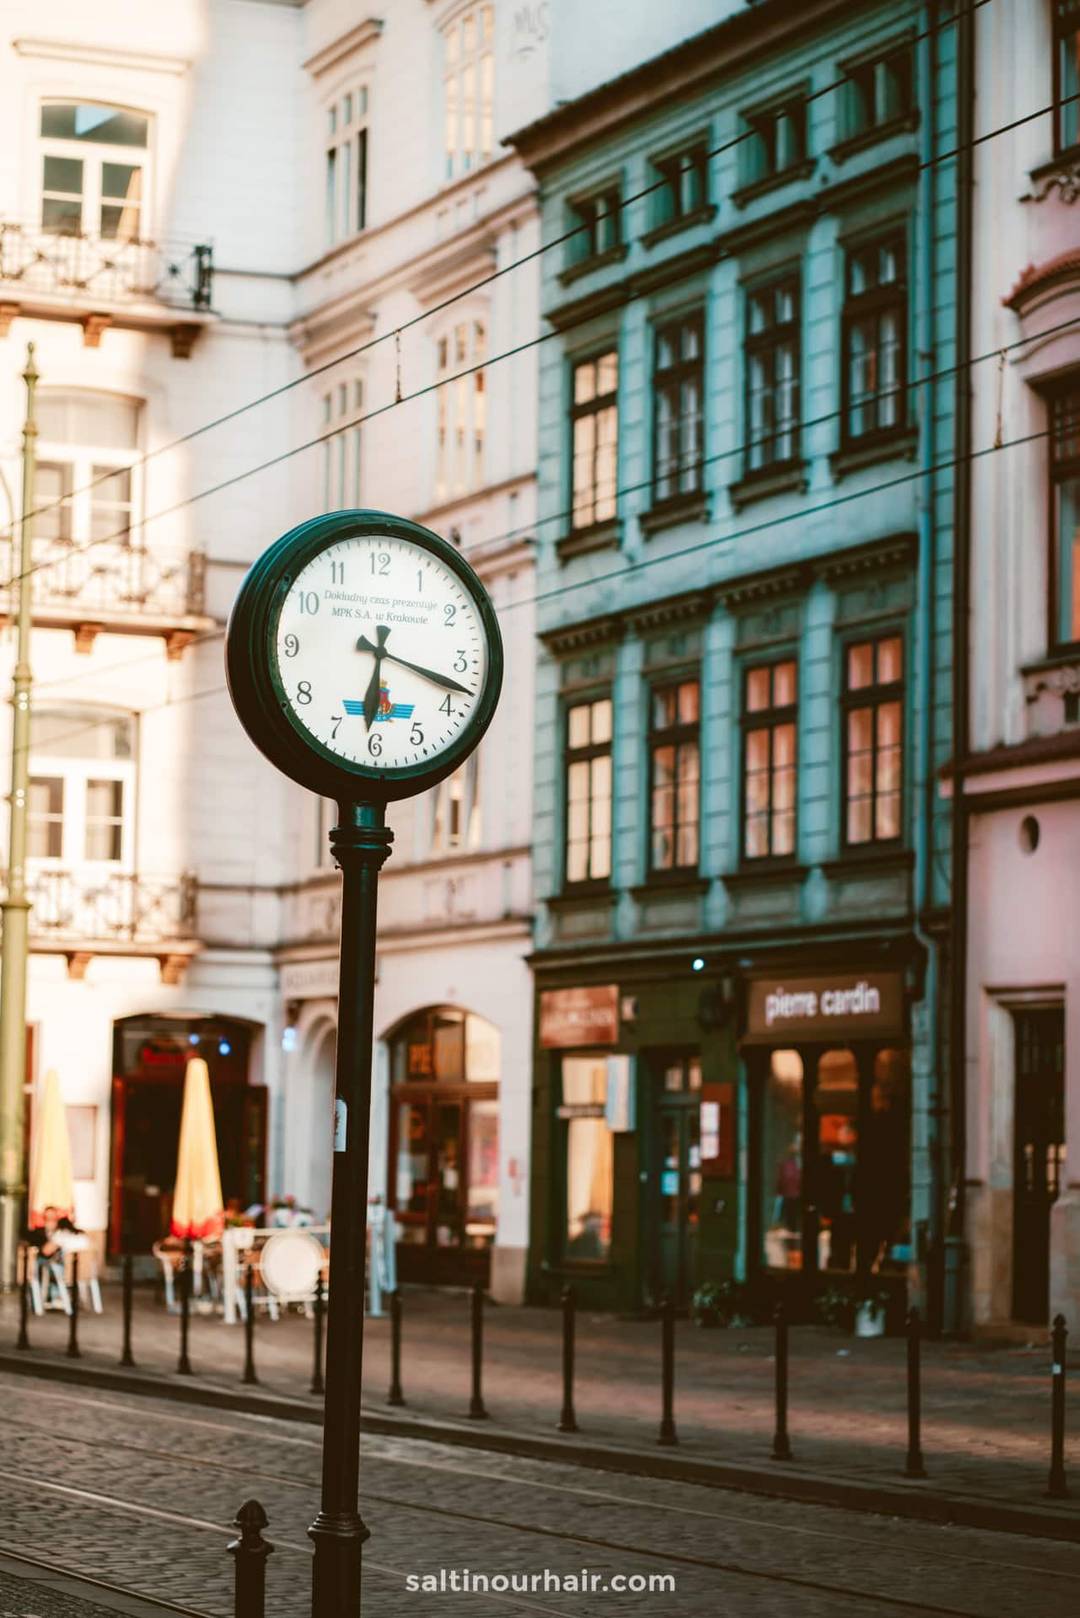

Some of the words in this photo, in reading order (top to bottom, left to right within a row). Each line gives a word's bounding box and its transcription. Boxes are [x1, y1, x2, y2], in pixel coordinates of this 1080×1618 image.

[331, 561, 344, 585] 11
[370, 552, 391, 575] 12
[417, 569, 422, 592] 1
[299, 591, 320, 615] 10
[369, 596, 391, 605] czas
[332, 607, 353, 618] MPK
[386, 612, 430, 625] Krakowie
[443, 604, 456, 627] 2
[284, 633, 299, 657] 9
[453, 650, 468, 673] 3
[297, 681, 312, 705] 8
[438, 694, 456, 717] 4
[331, 715, 343, 739] 7
[409, 722, 424, 746] 5
[367, 733, 382, 757] 6
[765, 986, 817, 1026] pierre
[820, 981, 880, 1015] cardin
